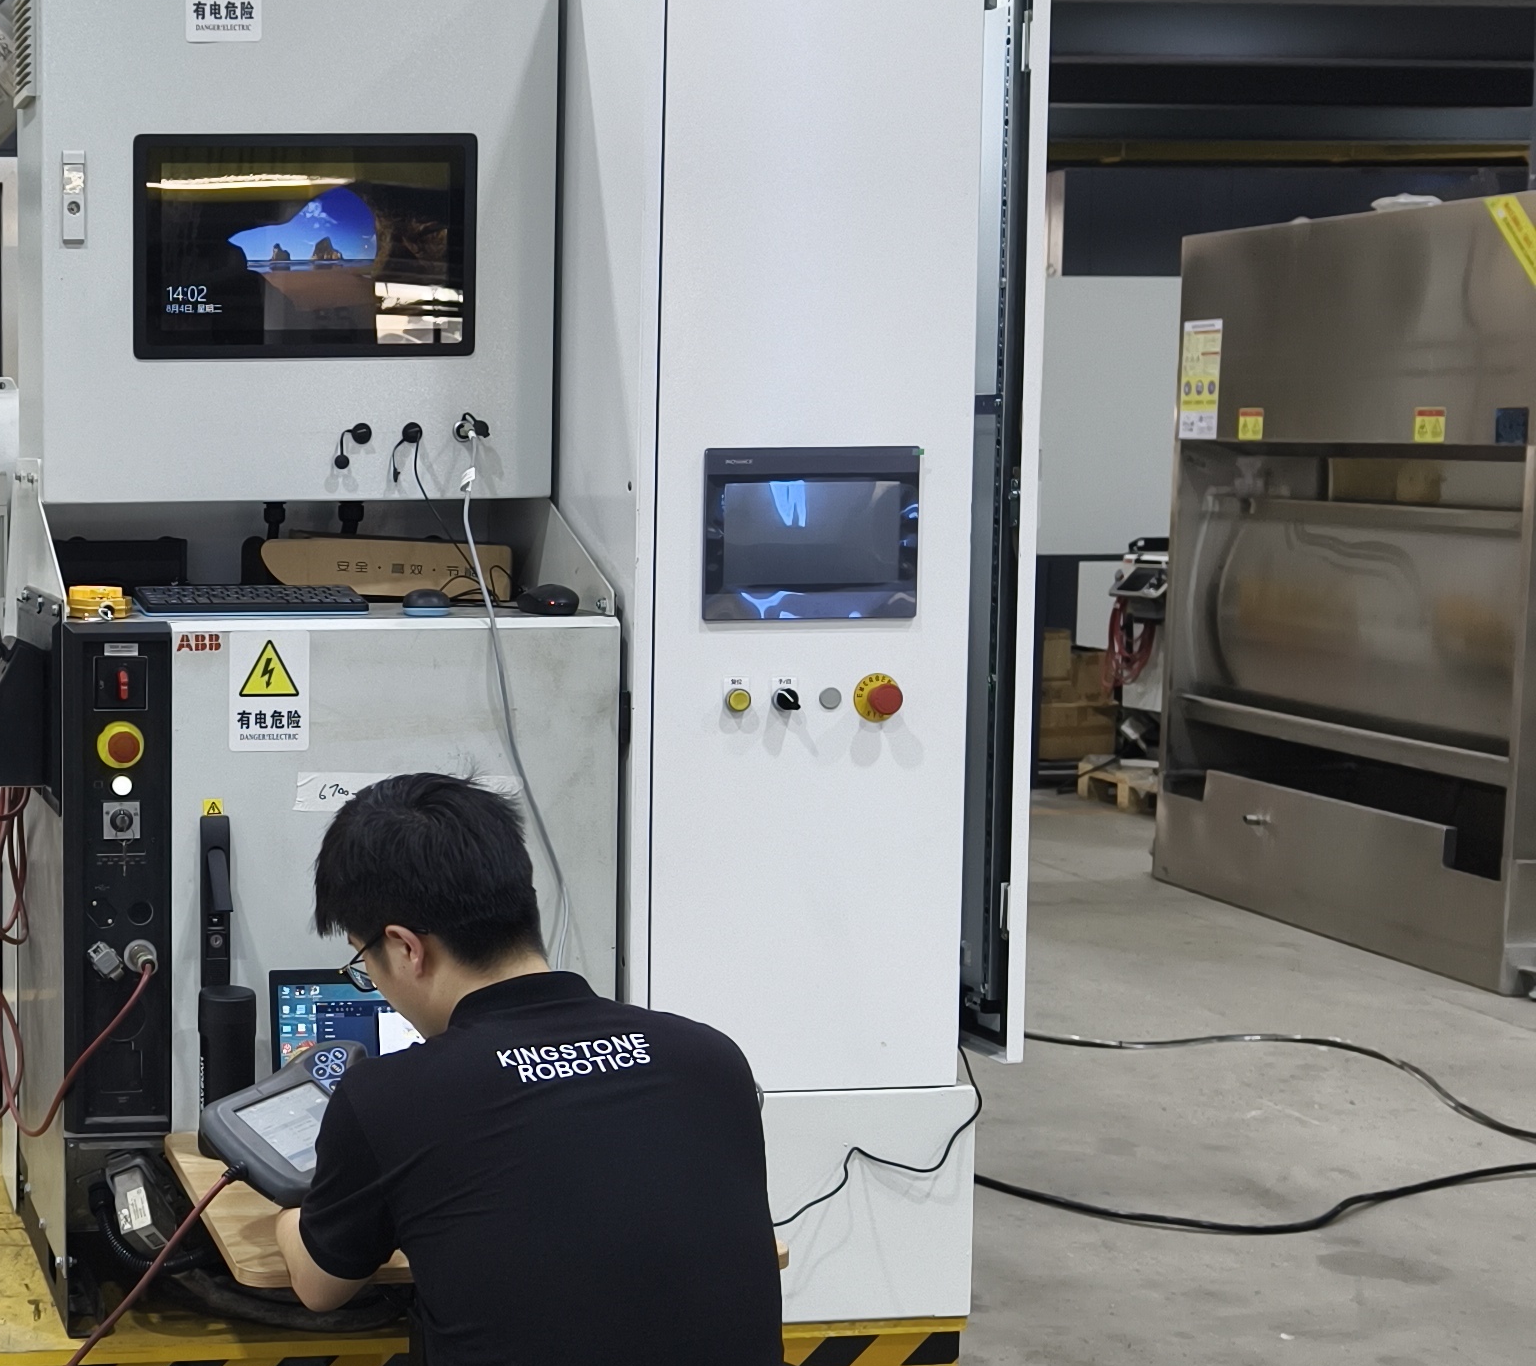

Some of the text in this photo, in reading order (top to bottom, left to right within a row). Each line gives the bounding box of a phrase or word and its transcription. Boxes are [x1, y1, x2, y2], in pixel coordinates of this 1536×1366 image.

[192, 0, 255, 20] 有电危险
[166, 285, 207, 302] 14:02
[177, 633, 221, 652] ABB
[237, 709, 302, 730] 有电危险
[496, 1033, 650, 1067] KINGSTONE
[517, 1048, 651, 1083] ROBOTICS
